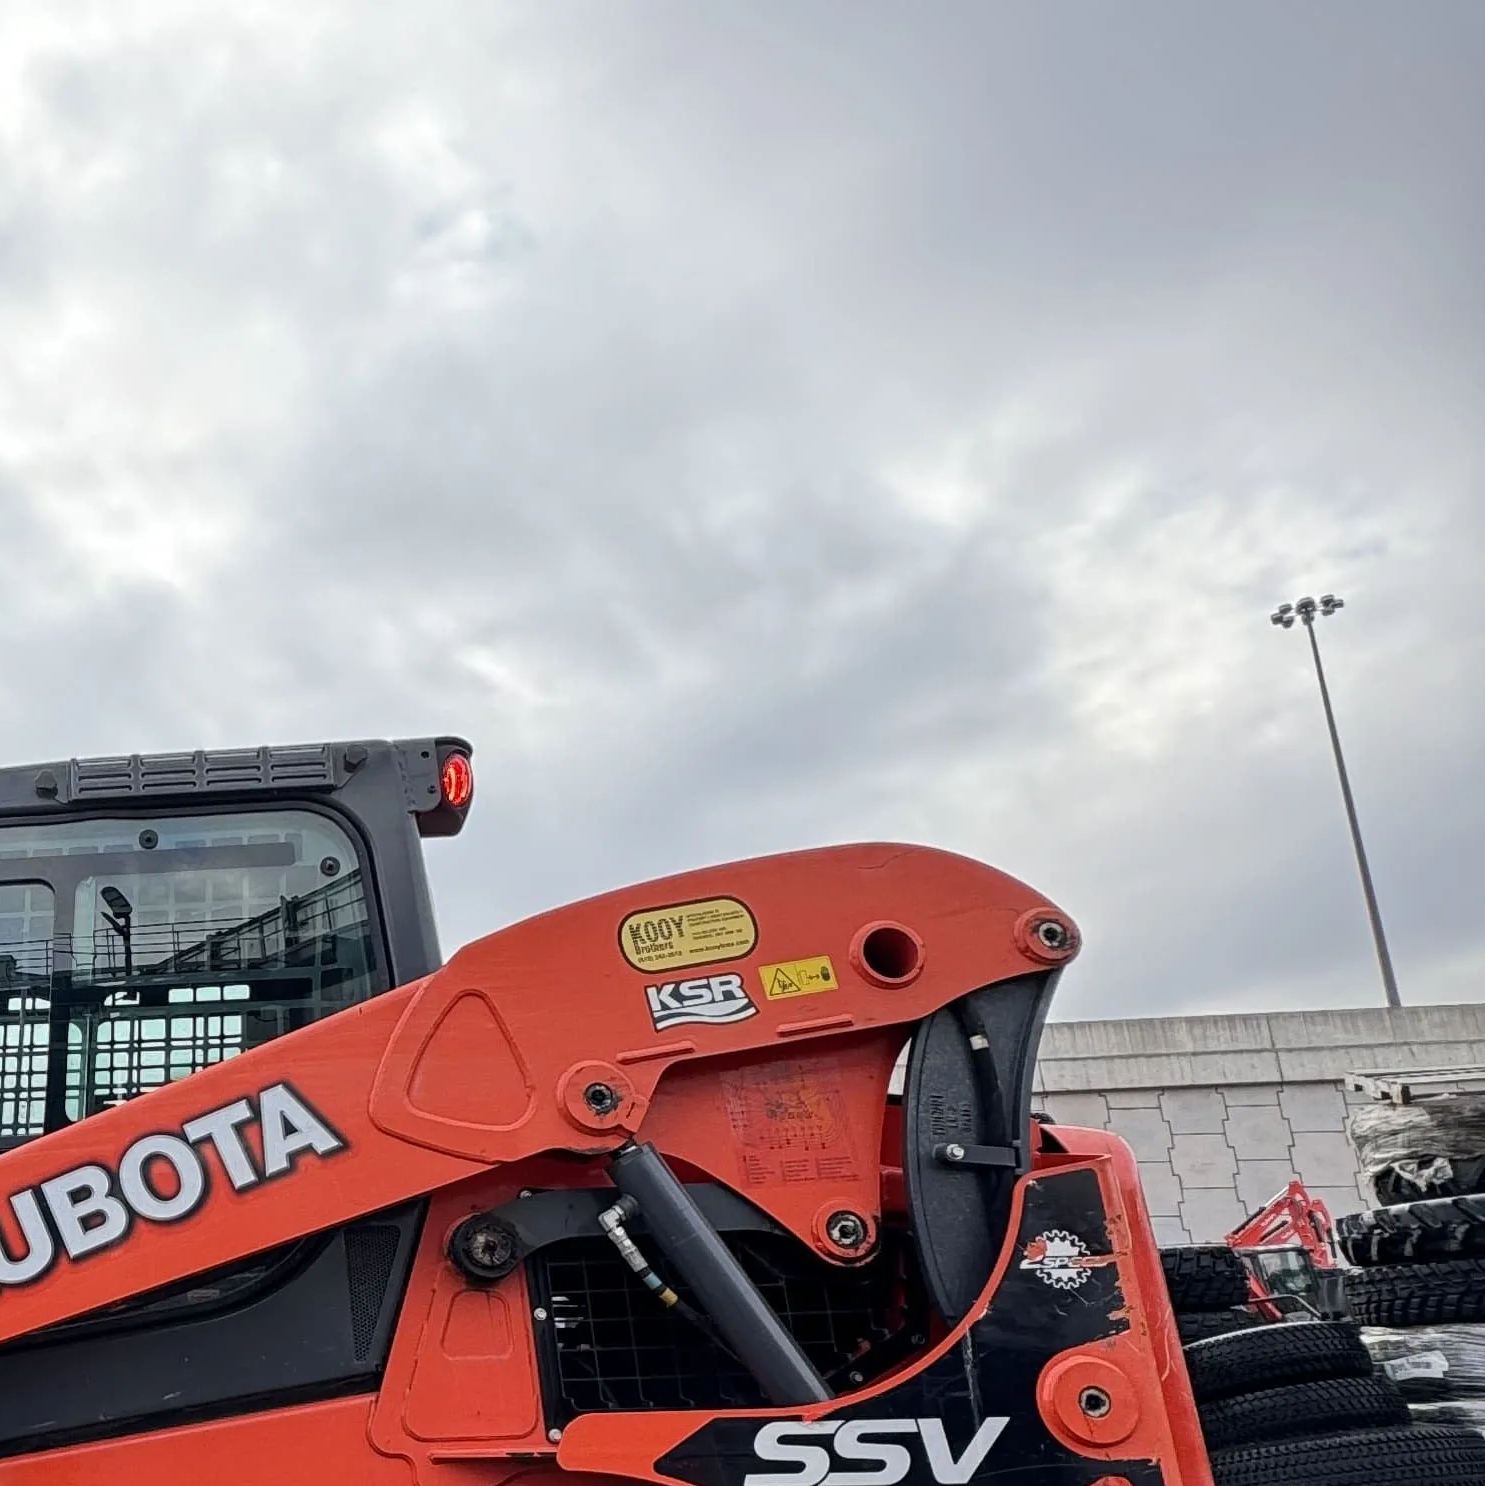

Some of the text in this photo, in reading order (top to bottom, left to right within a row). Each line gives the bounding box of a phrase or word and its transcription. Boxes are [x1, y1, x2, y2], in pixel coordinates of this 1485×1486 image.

[629, 915, 684, 944] KOOY
[633, 940, 674, 955] Brothers
[646, 974, 746, 1011] KSR
